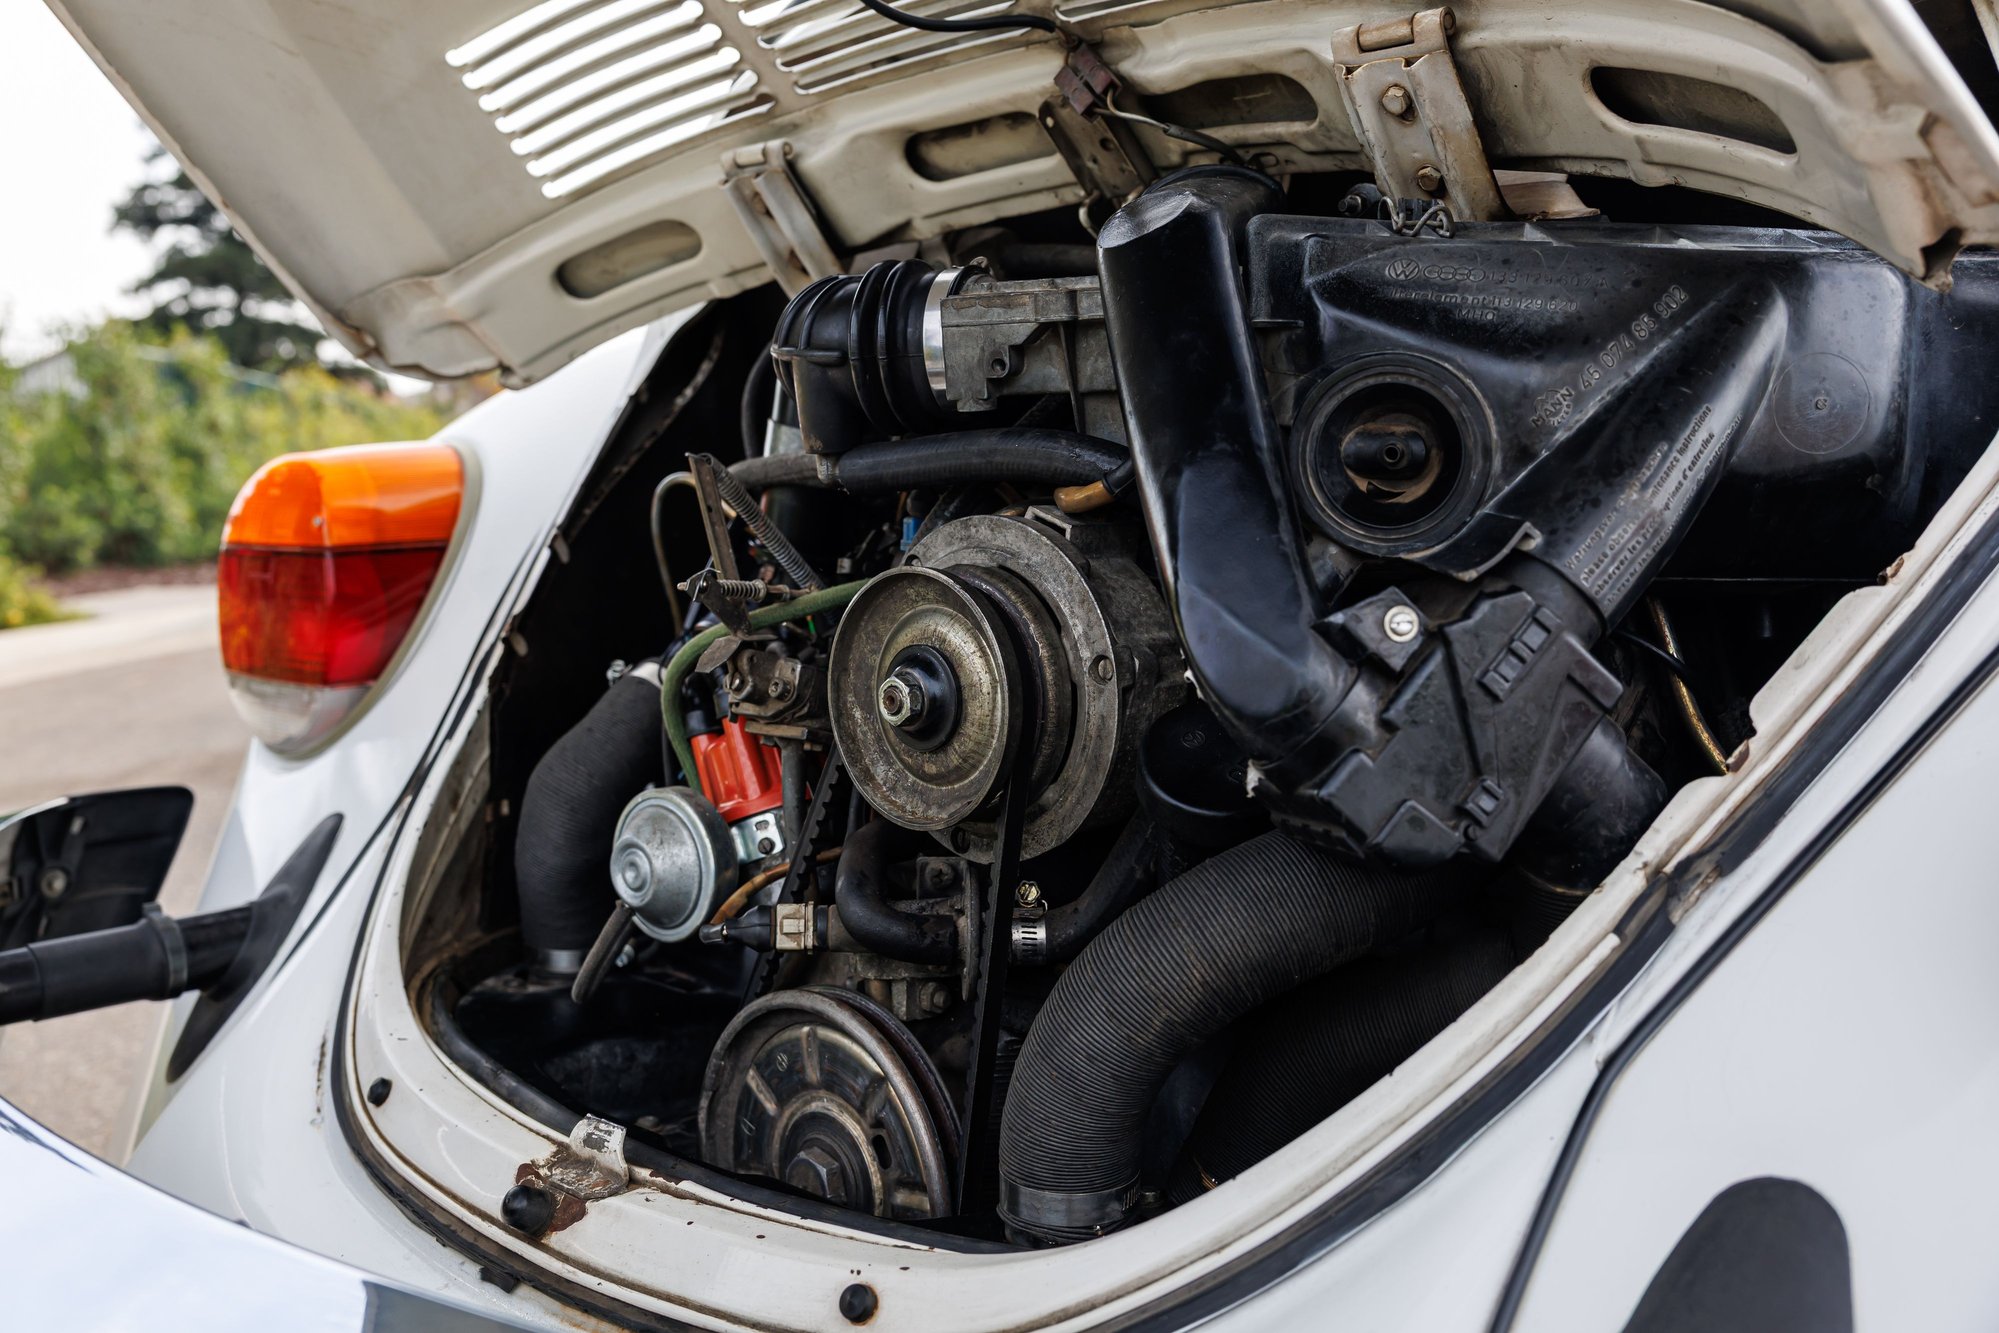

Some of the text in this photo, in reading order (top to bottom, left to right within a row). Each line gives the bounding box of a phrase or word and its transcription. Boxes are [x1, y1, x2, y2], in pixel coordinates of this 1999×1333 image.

[1516, 297, 1543, 310] 129
[1547, 299, 1578, 313] 620
[1579, 284, 1689, 391] 45 074 85 902
[1532, 387, 1574, 428] MANN
[1548, 403, 1572, 427] ILTER
